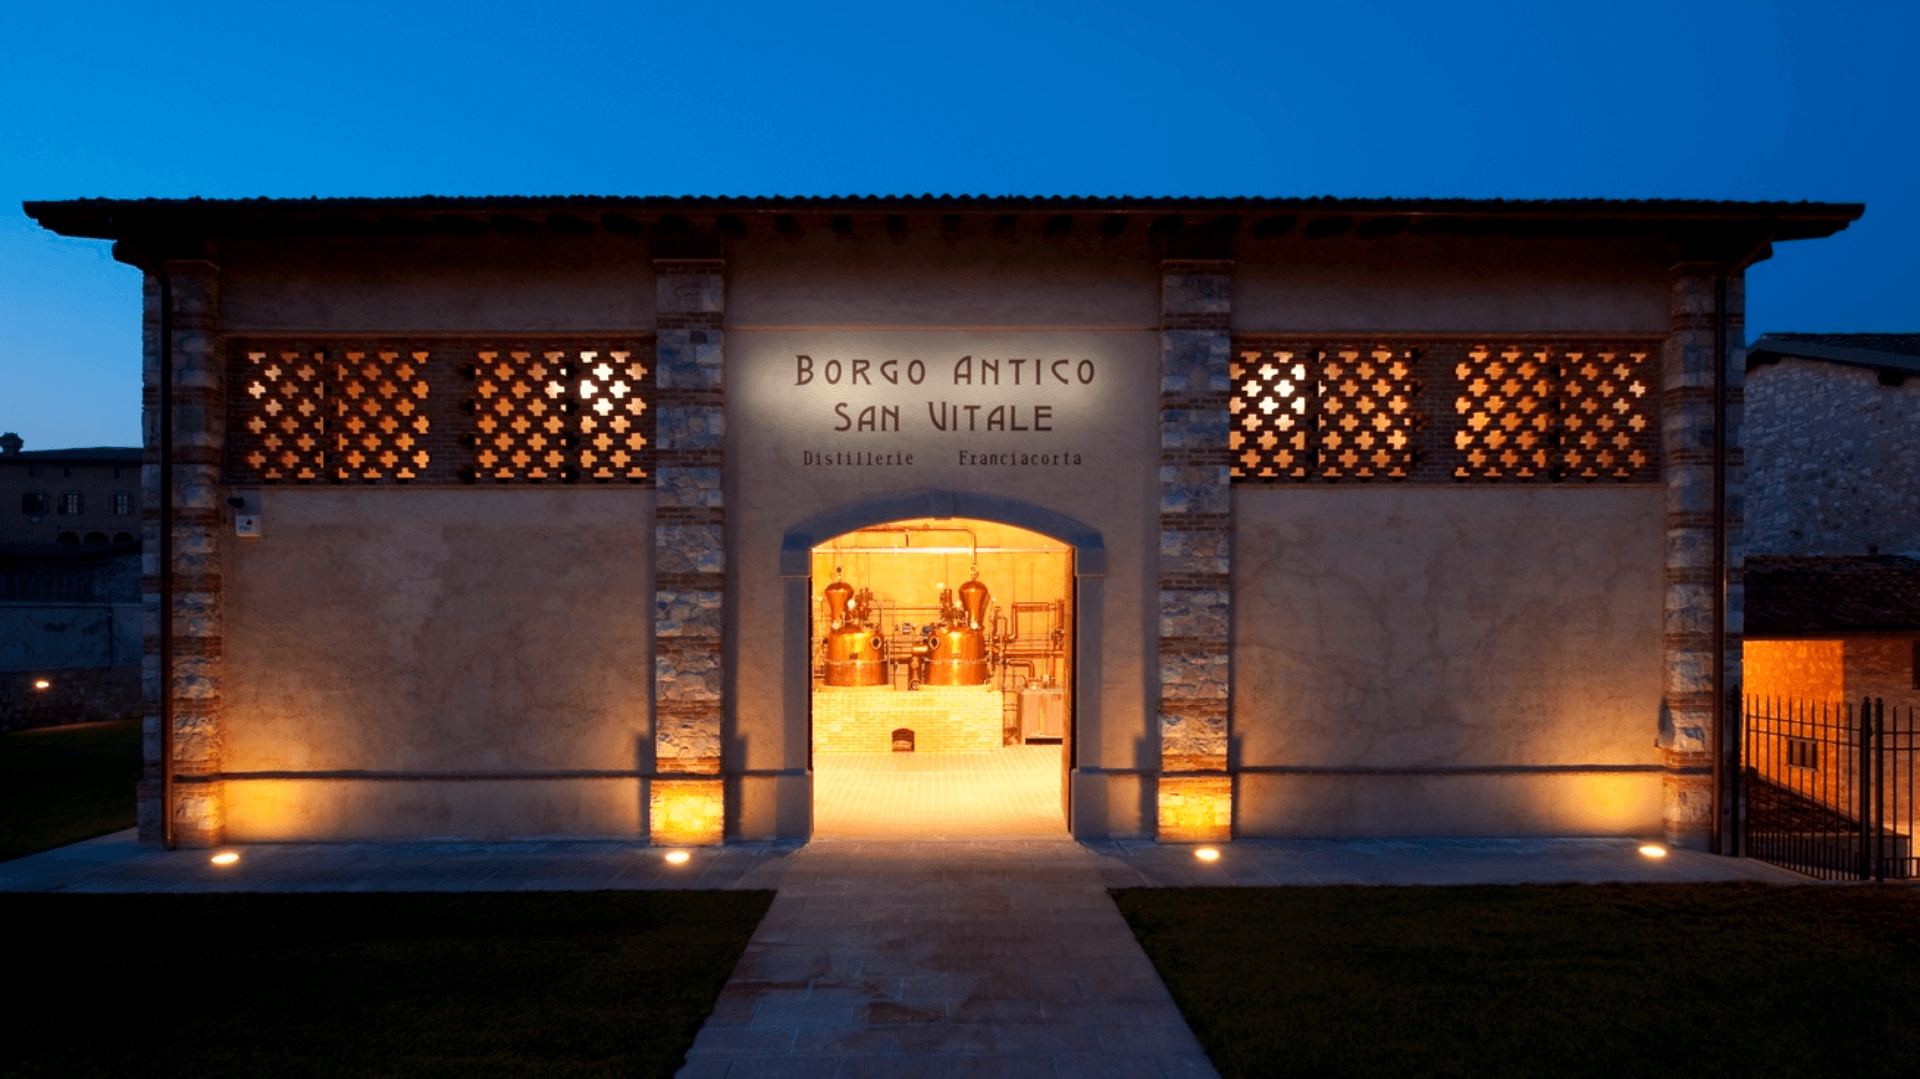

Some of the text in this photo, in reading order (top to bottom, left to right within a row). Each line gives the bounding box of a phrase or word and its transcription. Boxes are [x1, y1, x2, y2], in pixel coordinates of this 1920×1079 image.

[794, 354, 1095, 386] BORGO ANTICO
[834, 401, 1053, 432] SAN VITALE
[803, 450, 1082, 467] Distillerie Franciacorta
